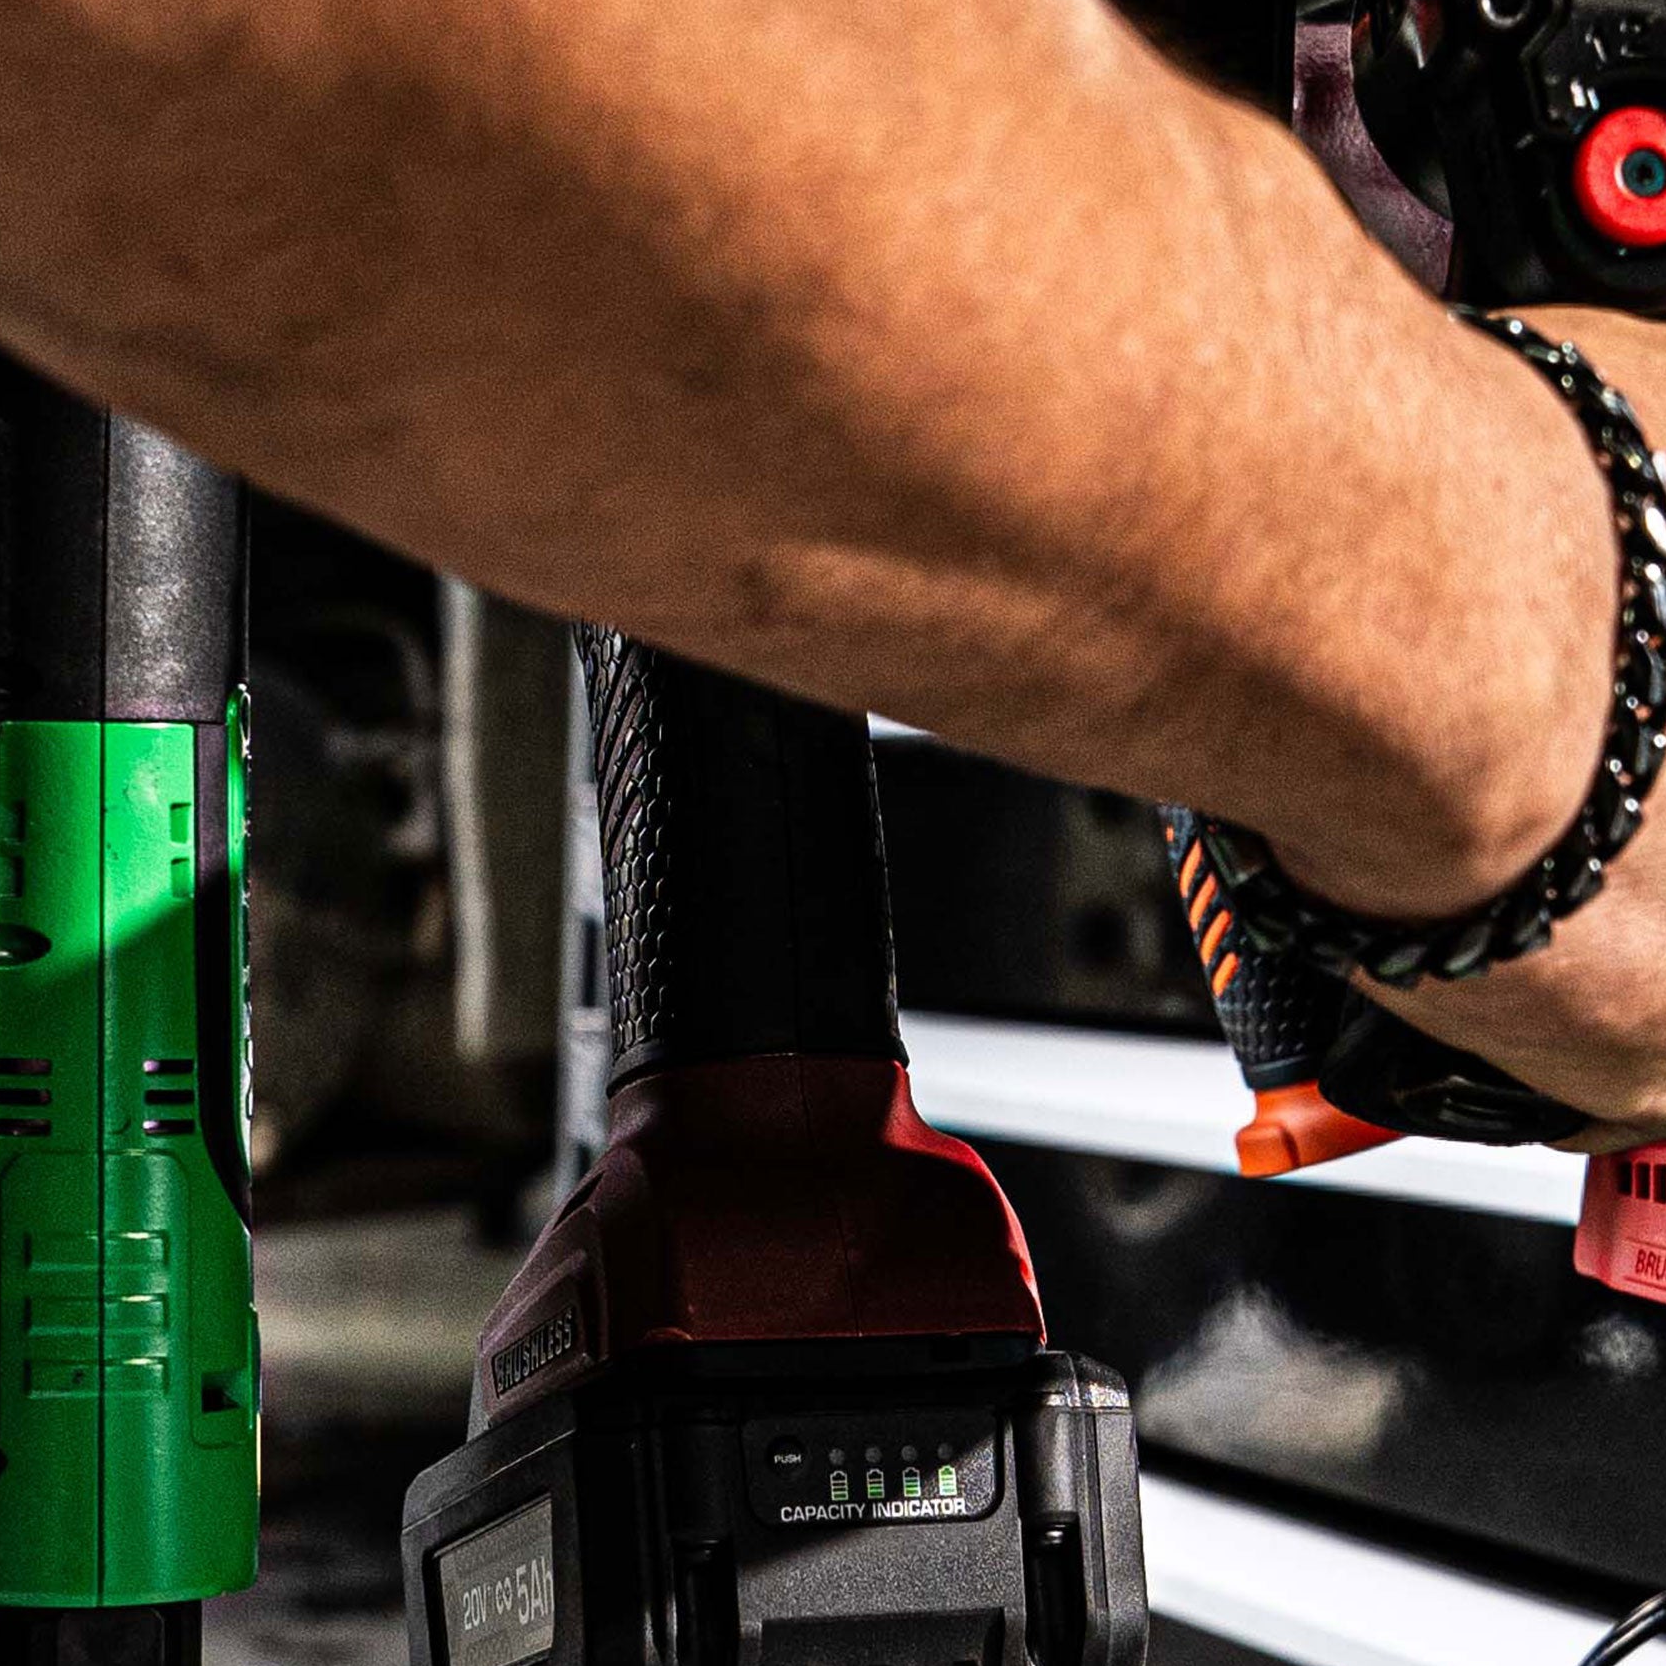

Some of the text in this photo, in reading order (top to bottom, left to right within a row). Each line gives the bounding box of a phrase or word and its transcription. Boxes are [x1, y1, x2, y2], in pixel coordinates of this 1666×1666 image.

[495, 1309, 573, 1393] BRUSHLESS
[773, 1453, 802, 1465] PUSH
[780, 1498, 967, 1522] CAPACITY INDICATOR
[516, 1556, 555, 1626] 5Ah
